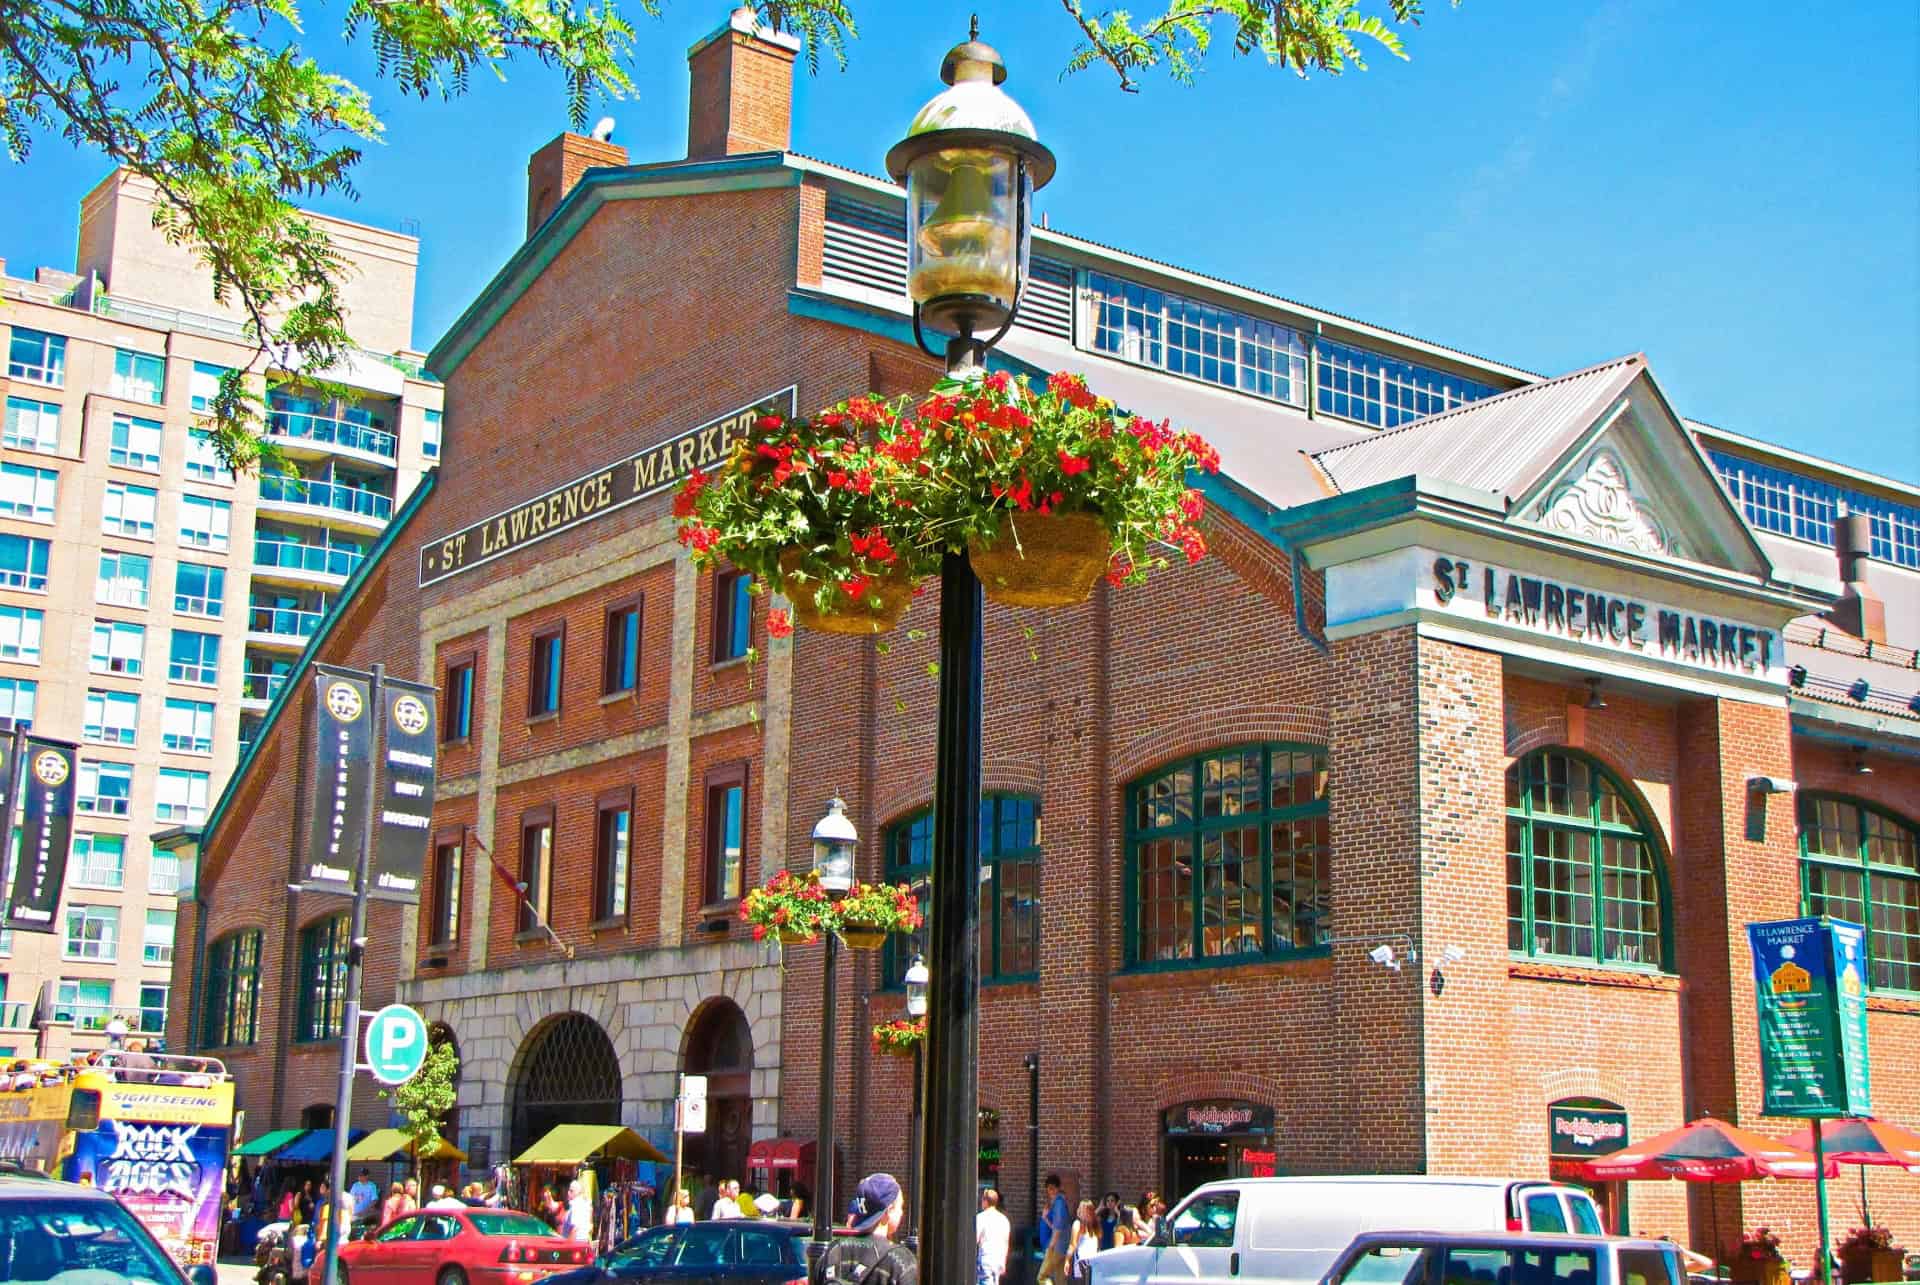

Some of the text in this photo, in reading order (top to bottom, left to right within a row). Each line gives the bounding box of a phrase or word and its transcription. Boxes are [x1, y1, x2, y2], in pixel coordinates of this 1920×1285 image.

[481, 471, 612, 555] LAWRENCE
[633, 410, 757, 492] MARKET
[1484, 567, 1648, 651] LAWRENCE
[1658, 609, 1773, 676] MARKET
[330, 730, 350, 854] CELEBRATE
[1766, 924, 1815, 937] LAWRENCE
[1768, 934, 1804, 945] MARKET
[382, 1017, 416, 1060] P
[112, 1092, 217, 1106] SIGHTSEEING
[110, 1119, 202, 1162] ROCK
[104, 1161, 195, 1197] AGES
